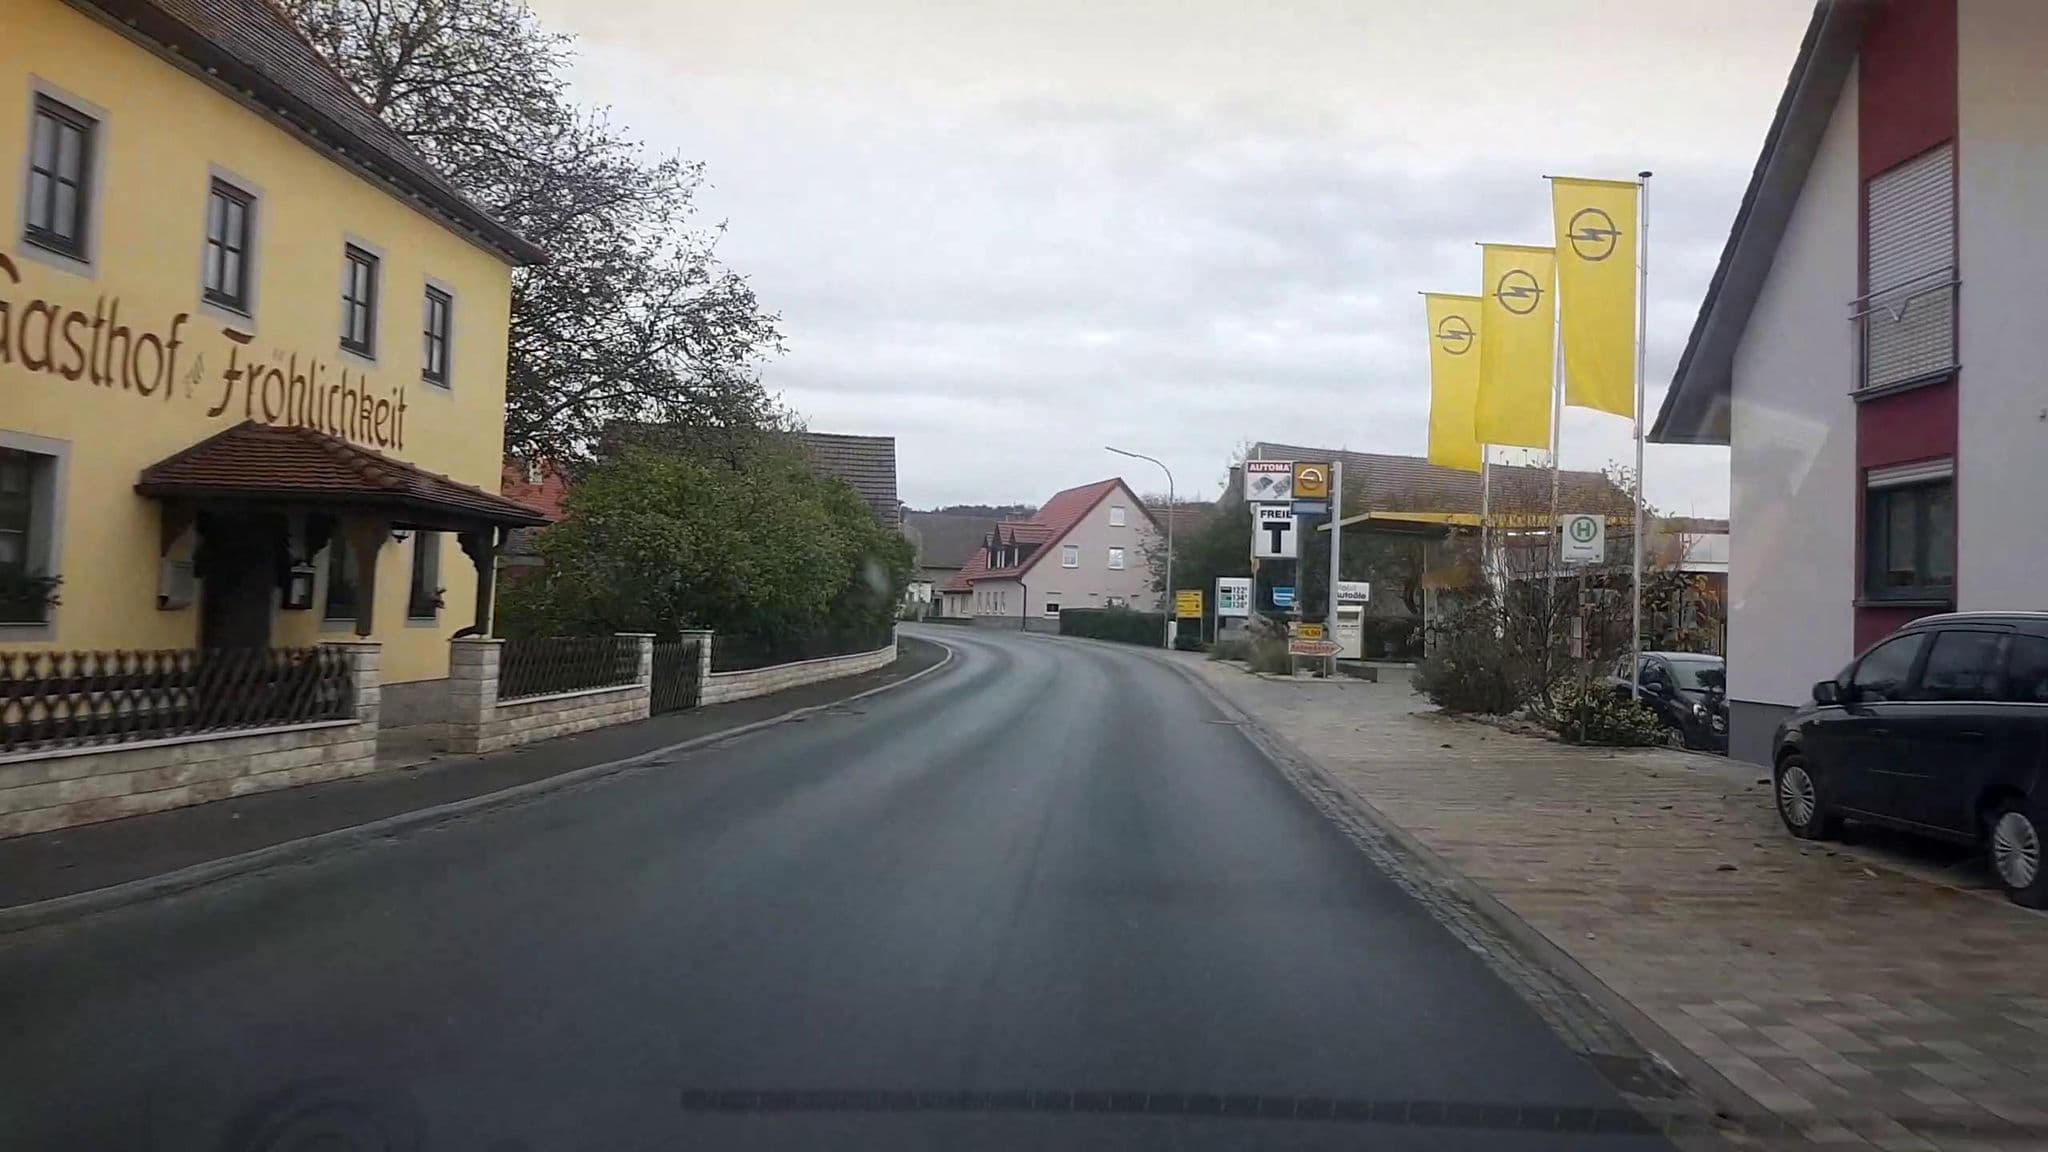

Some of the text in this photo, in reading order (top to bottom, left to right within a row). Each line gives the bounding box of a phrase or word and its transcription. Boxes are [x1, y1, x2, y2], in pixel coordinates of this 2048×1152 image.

[208, 328, 409, 451] Fröhlichkeit
[1249, 463, 1291, 472] AUTOMA
[1577, 522, 1590, 537] H
[1263, 522, 1291, 553] T
[1337, 591, 1367, 599] utoöle
